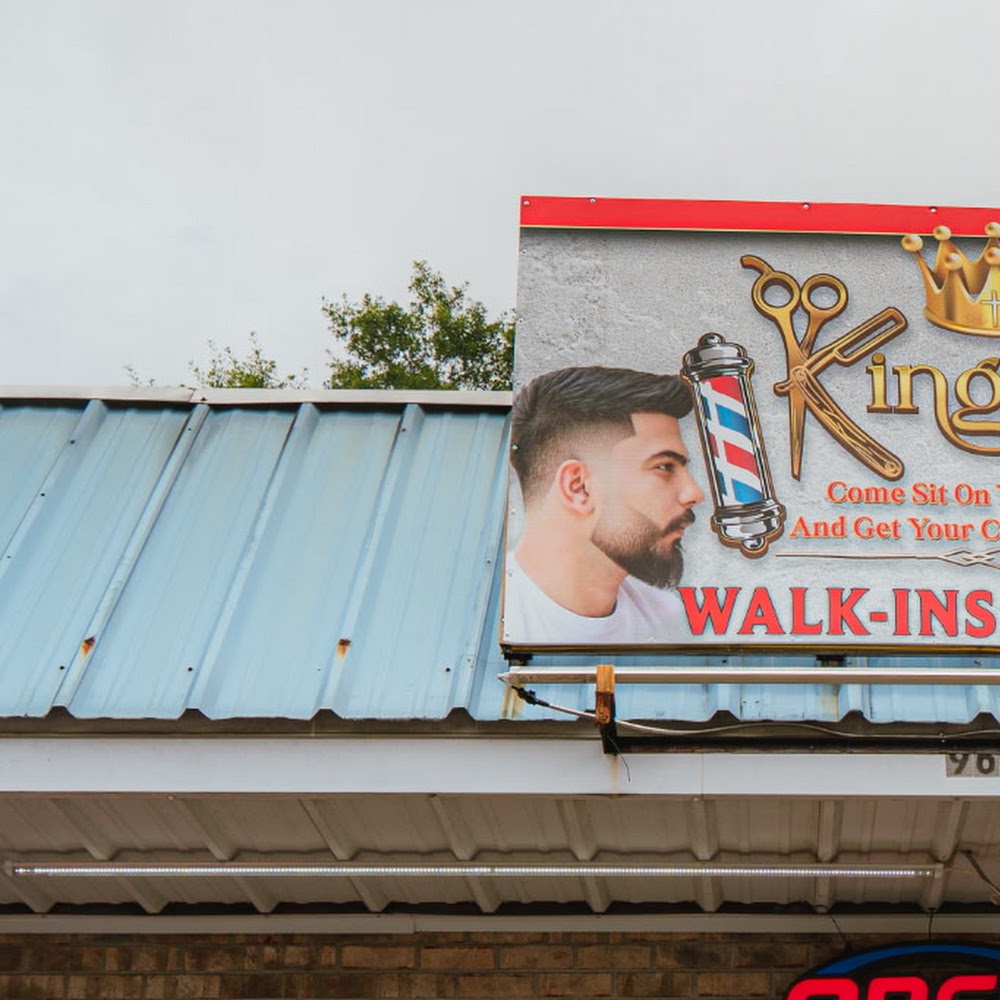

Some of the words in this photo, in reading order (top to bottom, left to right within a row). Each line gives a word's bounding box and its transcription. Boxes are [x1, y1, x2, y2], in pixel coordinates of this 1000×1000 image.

[826, 481, 906, 505] Come
[912, 481, 948, 506] Sit
[954, 483, 992, 506] On
[789, 516, 848, 541] And
[852, 517, 901, 541] Get
[908, 518, 975, 543] Your
[677, 586, 998, 638] WALK-INS
